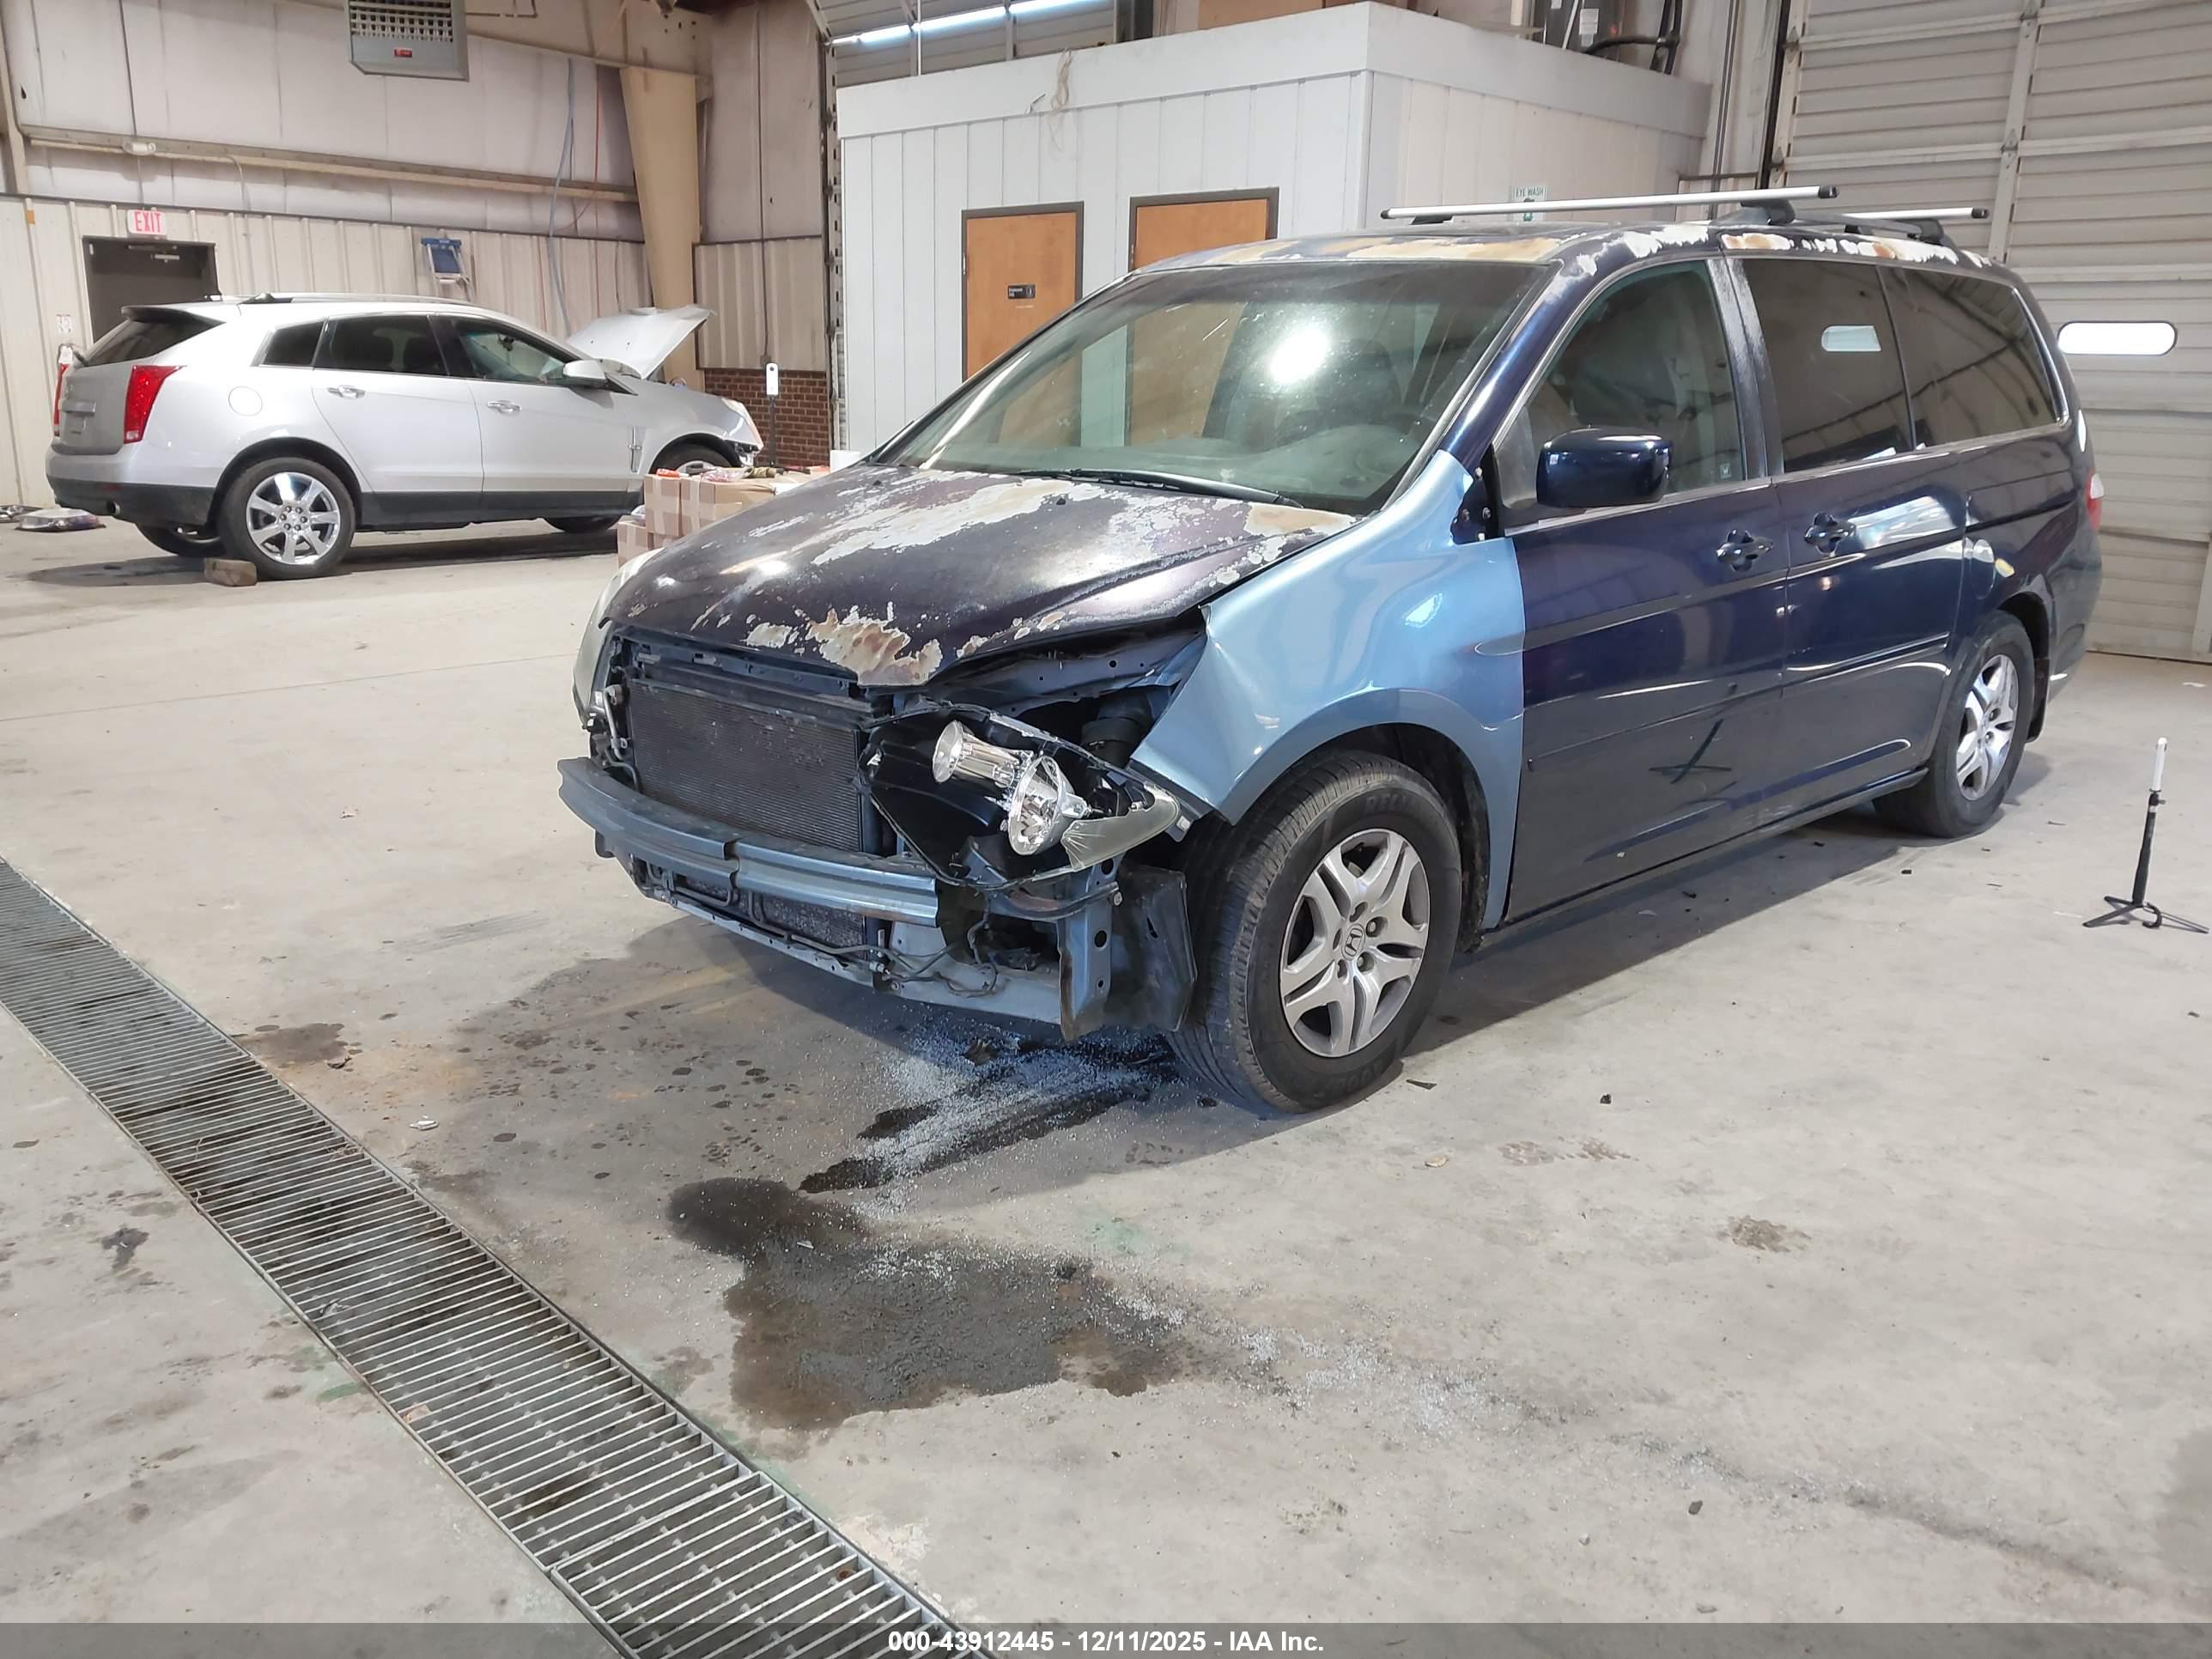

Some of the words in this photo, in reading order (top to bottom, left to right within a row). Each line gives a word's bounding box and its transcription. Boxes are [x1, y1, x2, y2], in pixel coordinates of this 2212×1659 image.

[1516, 187, 1525, 198] EYE
[1528, 186, 1544, 196] WASH
[134, 210, 161, 233] EXIT
